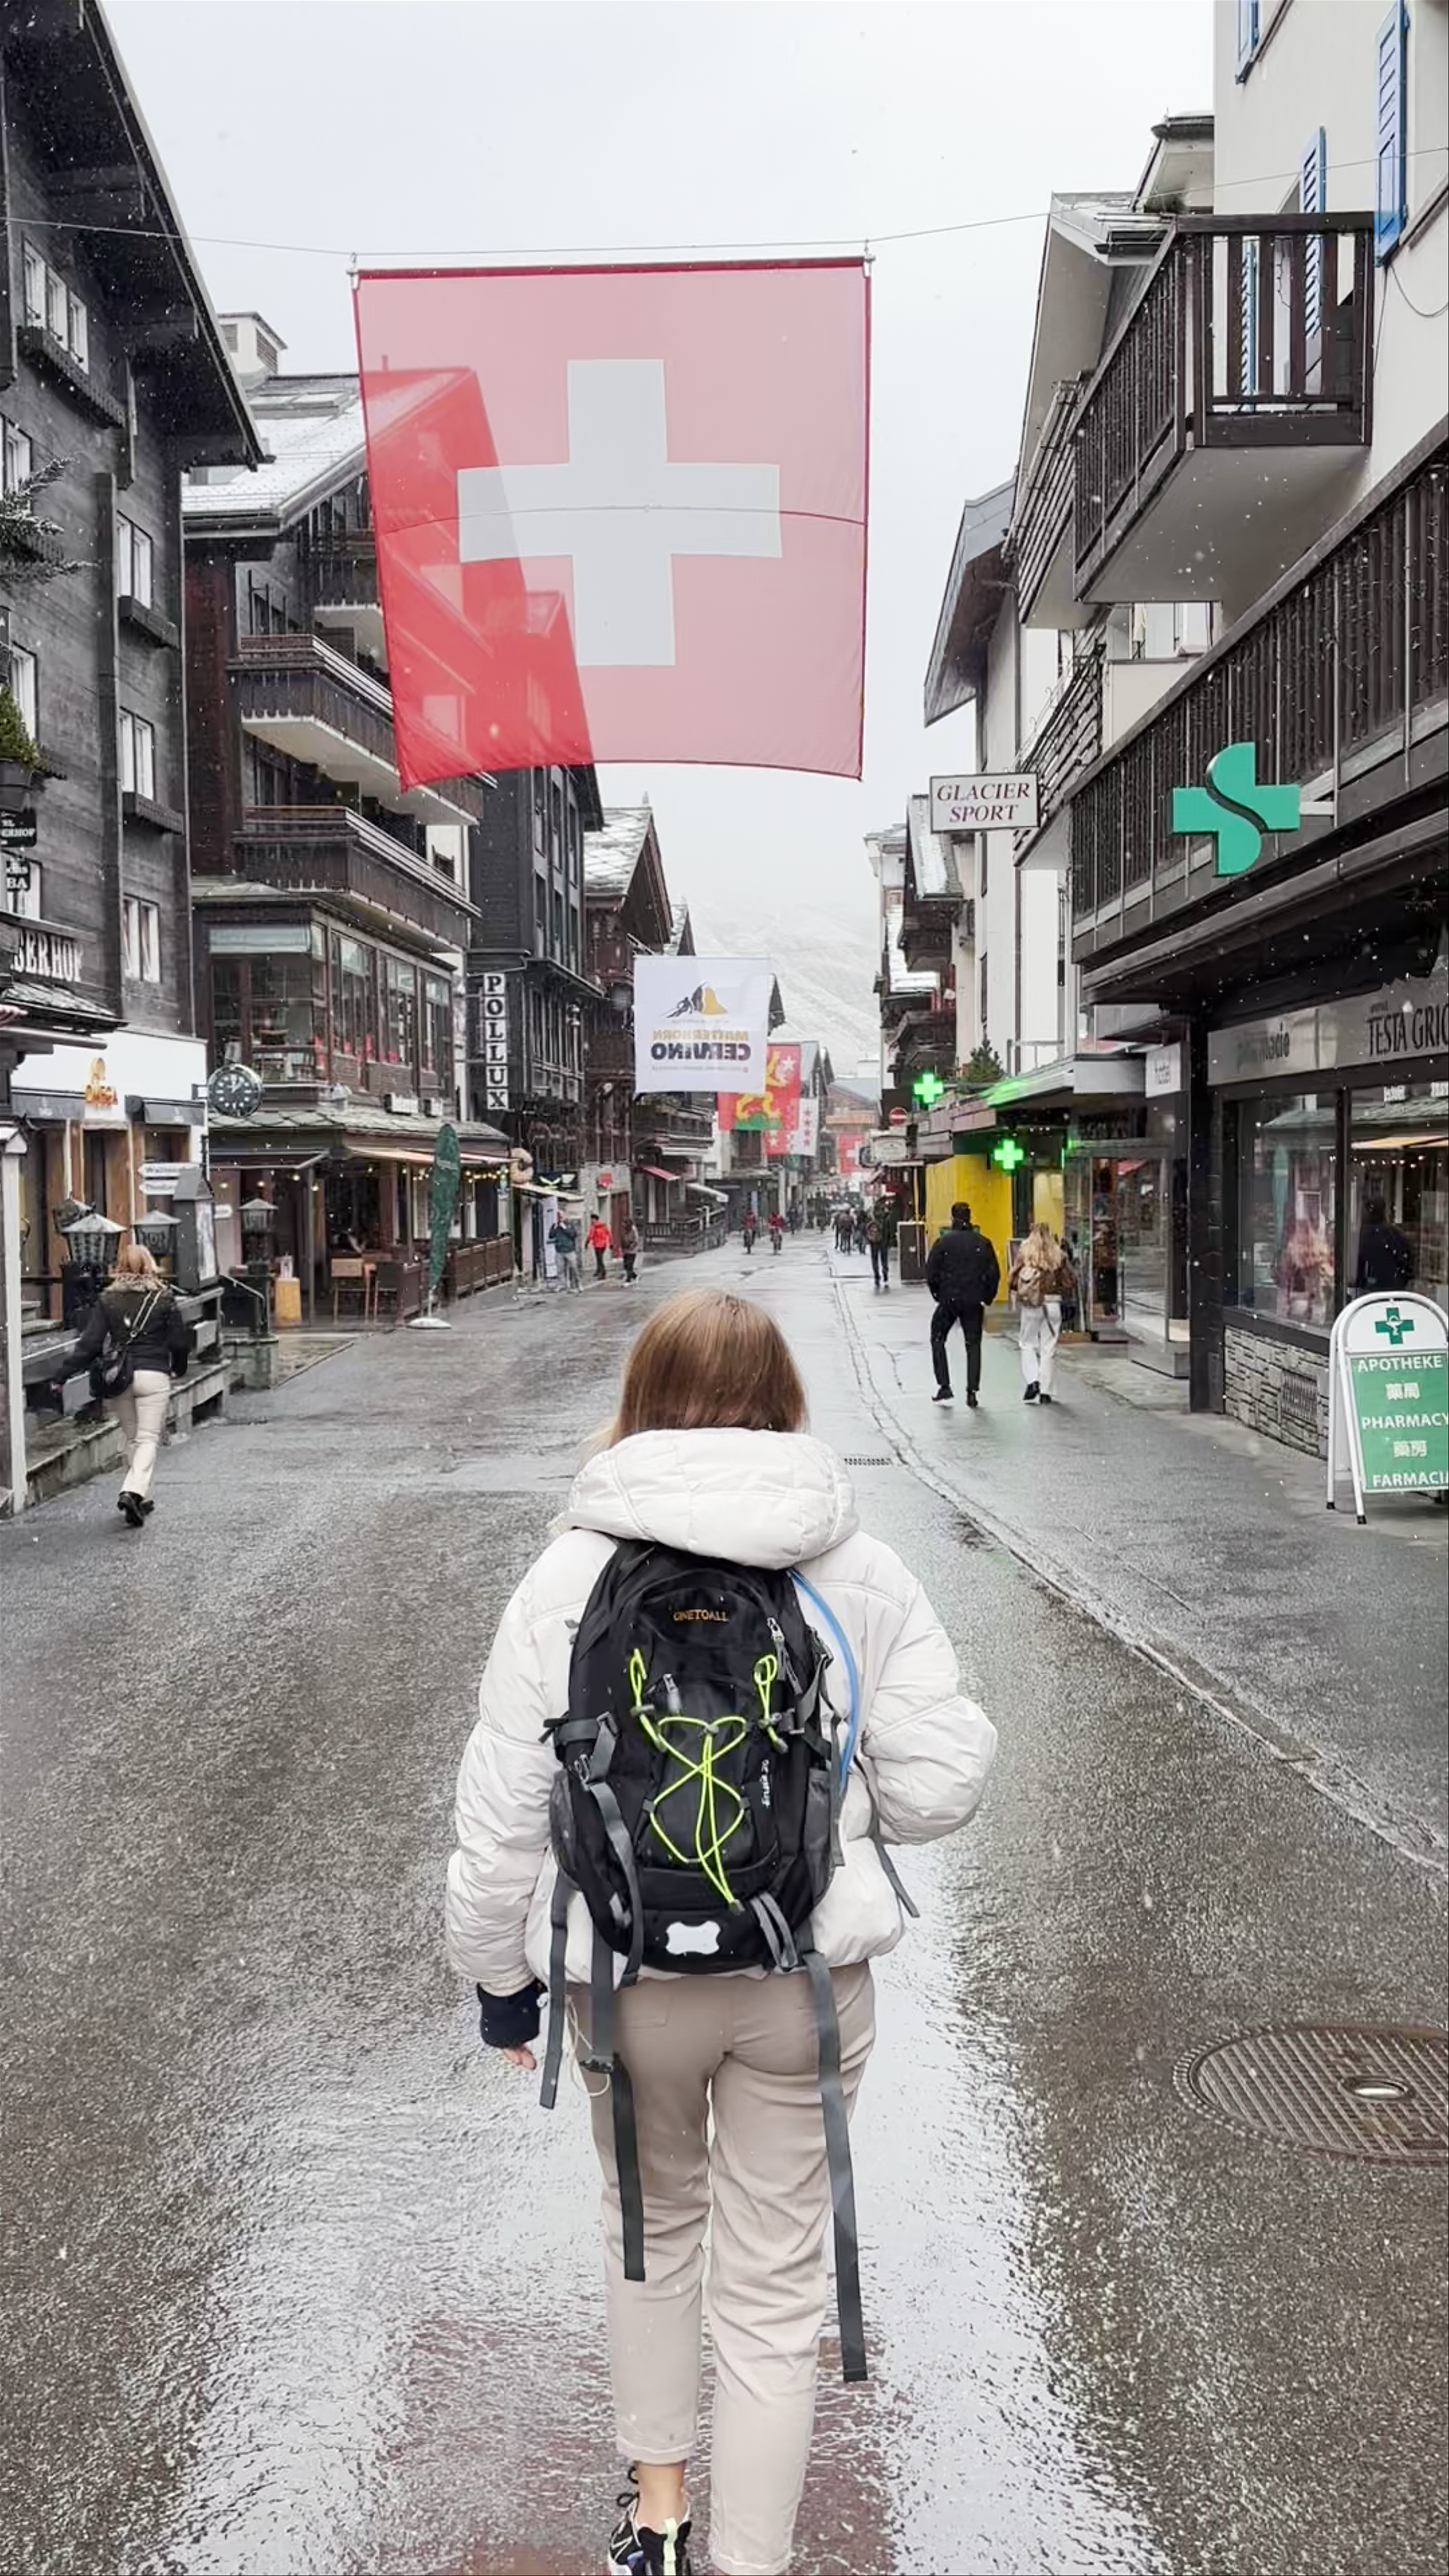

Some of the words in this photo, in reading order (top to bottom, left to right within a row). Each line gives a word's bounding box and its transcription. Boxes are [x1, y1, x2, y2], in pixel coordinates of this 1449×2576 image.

[937, 783, 1029, 801] GLACIER
[949, 804, 1019, 823] SPORT
[487, 975, 506, 1107] POLLUX
[1366, 1012, 1407, 1057] TESTA
[1358, 1356, 1443, 1372] APOTHEKE
[673, 1609, 729, 1622] ONETOALL
